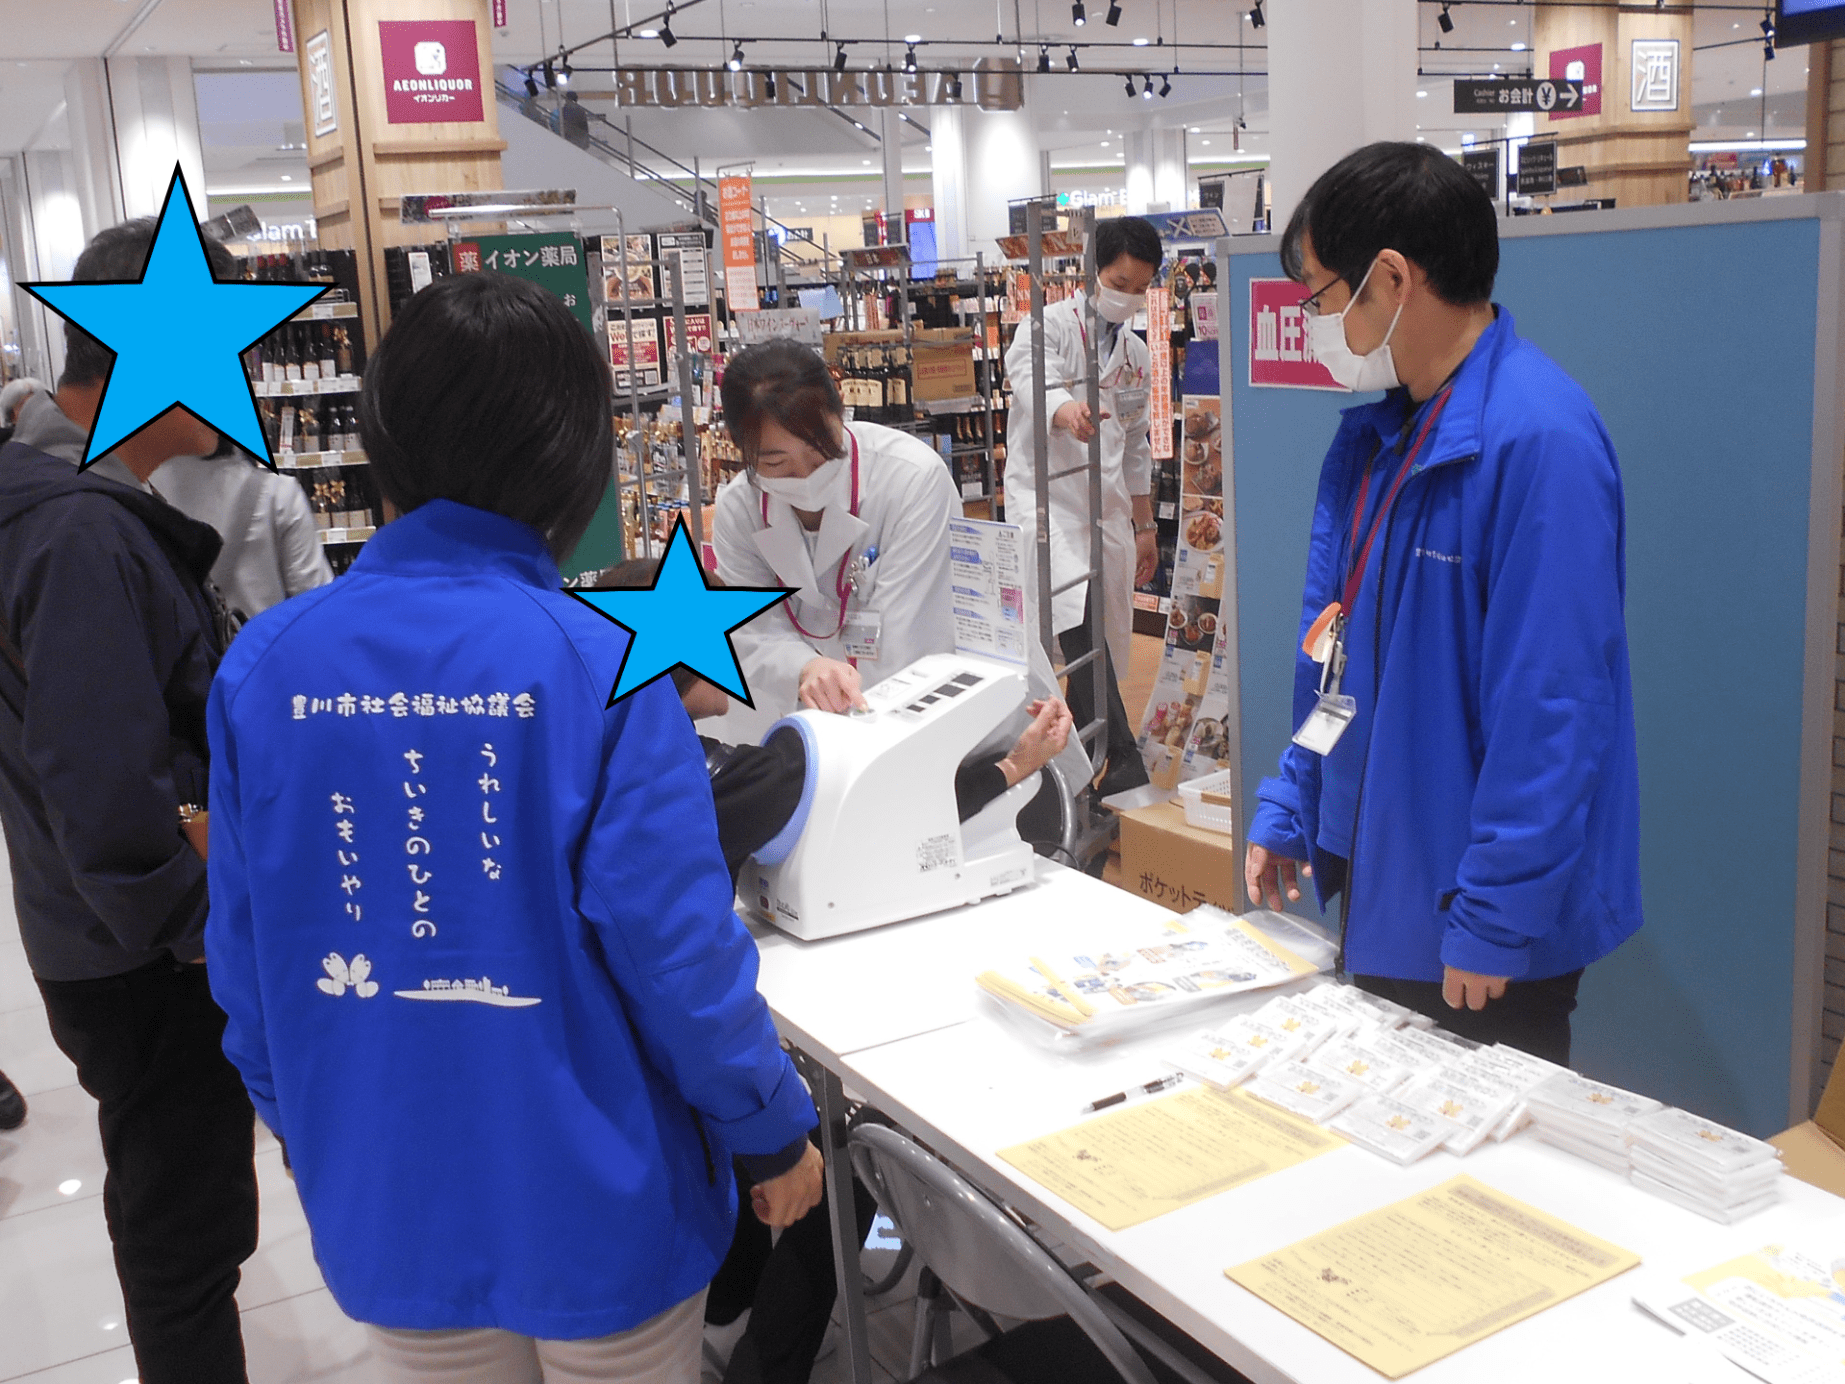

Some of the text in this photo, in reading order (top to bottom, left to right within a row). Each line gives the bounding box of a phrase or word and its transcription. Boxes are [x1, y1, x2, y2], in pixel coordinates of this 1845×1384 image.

[393, 79, 473, 91] AEONLIQUOR
[1637, 51, 1672, 101] 酒
[413, 94, 456, 103] イオンリカー
[1498, 88, 1533, 104] お会計
[459, 245, 578, 272] 薬 イオン薬局
[563, 293, 577, 307] お
[292, 692, 536, 720] 豊川市社会福祉協議会
[478, 743, 502, 880] うれしいな
[331, 792, 362, 921] おもいやり
[403, 749, 437, 938] ちいきのひとの
